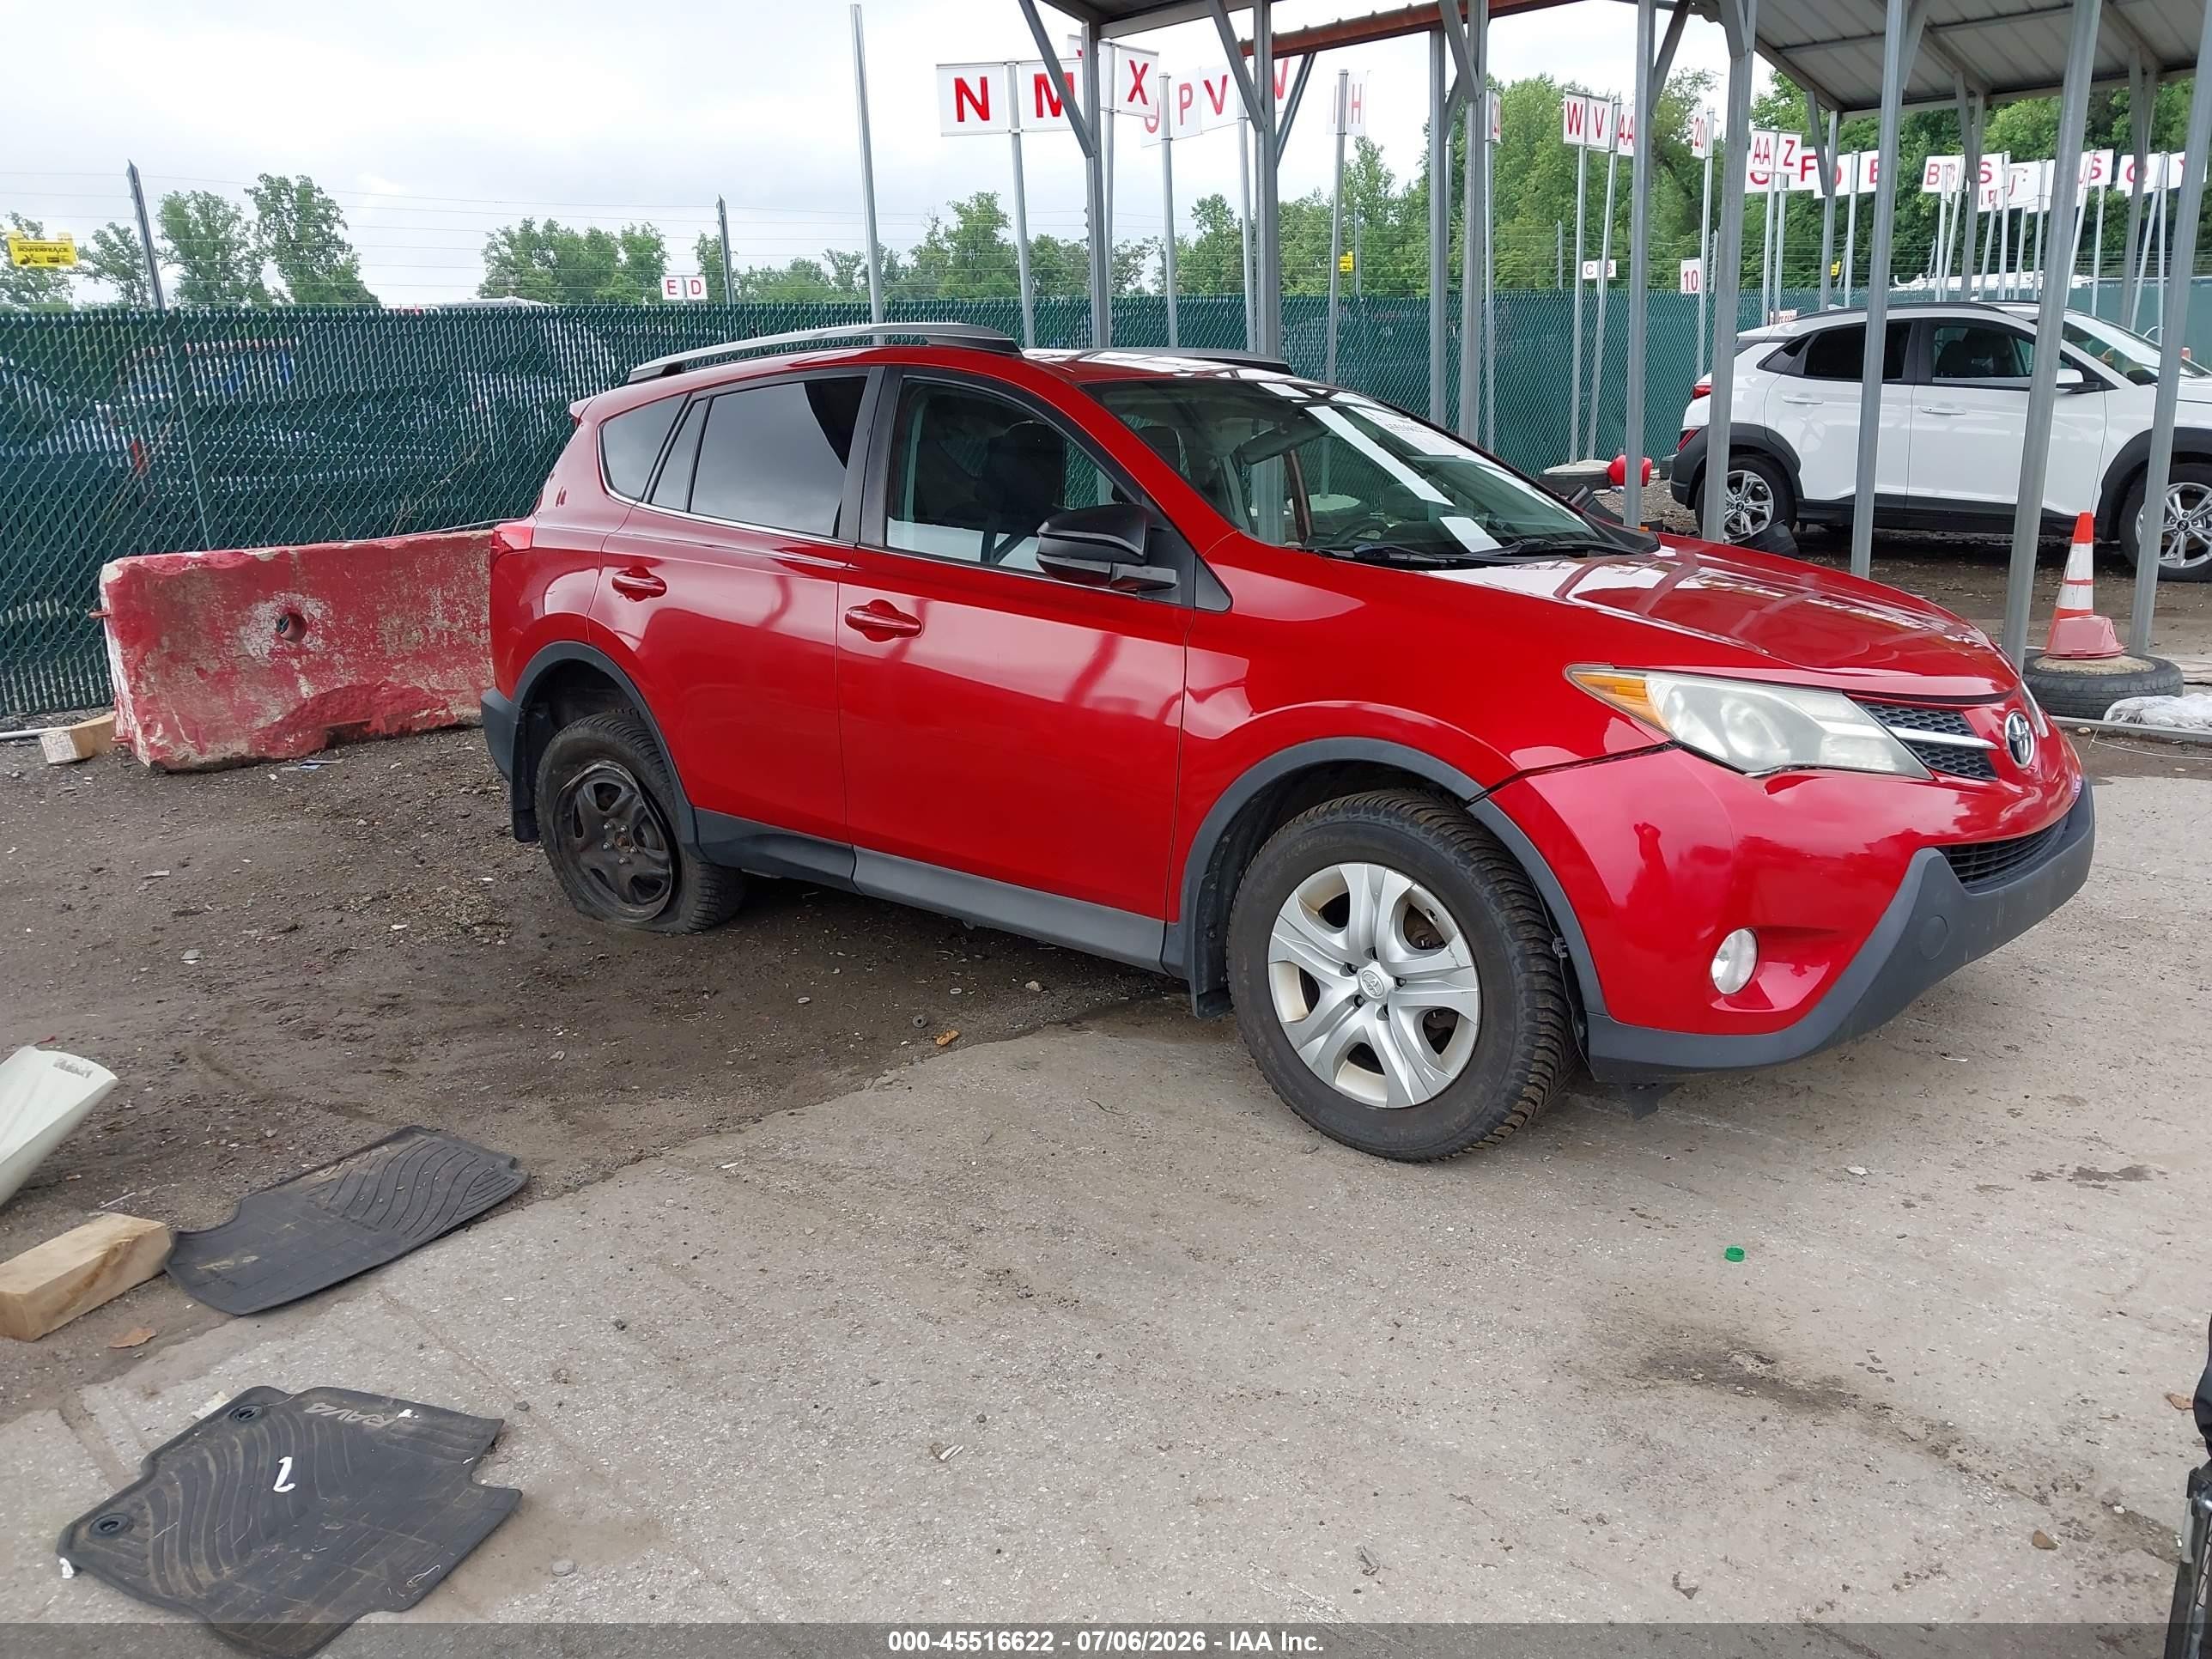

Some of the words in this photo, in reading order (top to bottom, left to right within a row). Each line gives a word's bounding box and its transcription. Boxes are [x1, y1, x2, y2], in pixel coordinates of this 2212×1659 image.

[1033, 72, 1075, 118] M
[1127, 59, 1149, 105] X
[1203, 74, 1228, 116] V
[954, 76, 990, 122] N
[1179, 82, 1194, 126] P
[1352, 82, 1363, 125] H
[1566, 100, 1583, 136] W
[1594, 106, 1606, 139] V
[1694, 117, 1705, 149] 20
[1753, 137, 1771, 166] AA
[1783, 139, 1796, 167] Z
[1800, 155, 1818, 182] F
[1584, 264, 1595, 276] C
[1683, 269, 1698, 292] 10
[666, 279, 678, 295] E
[690, 279, 702, 295] D
